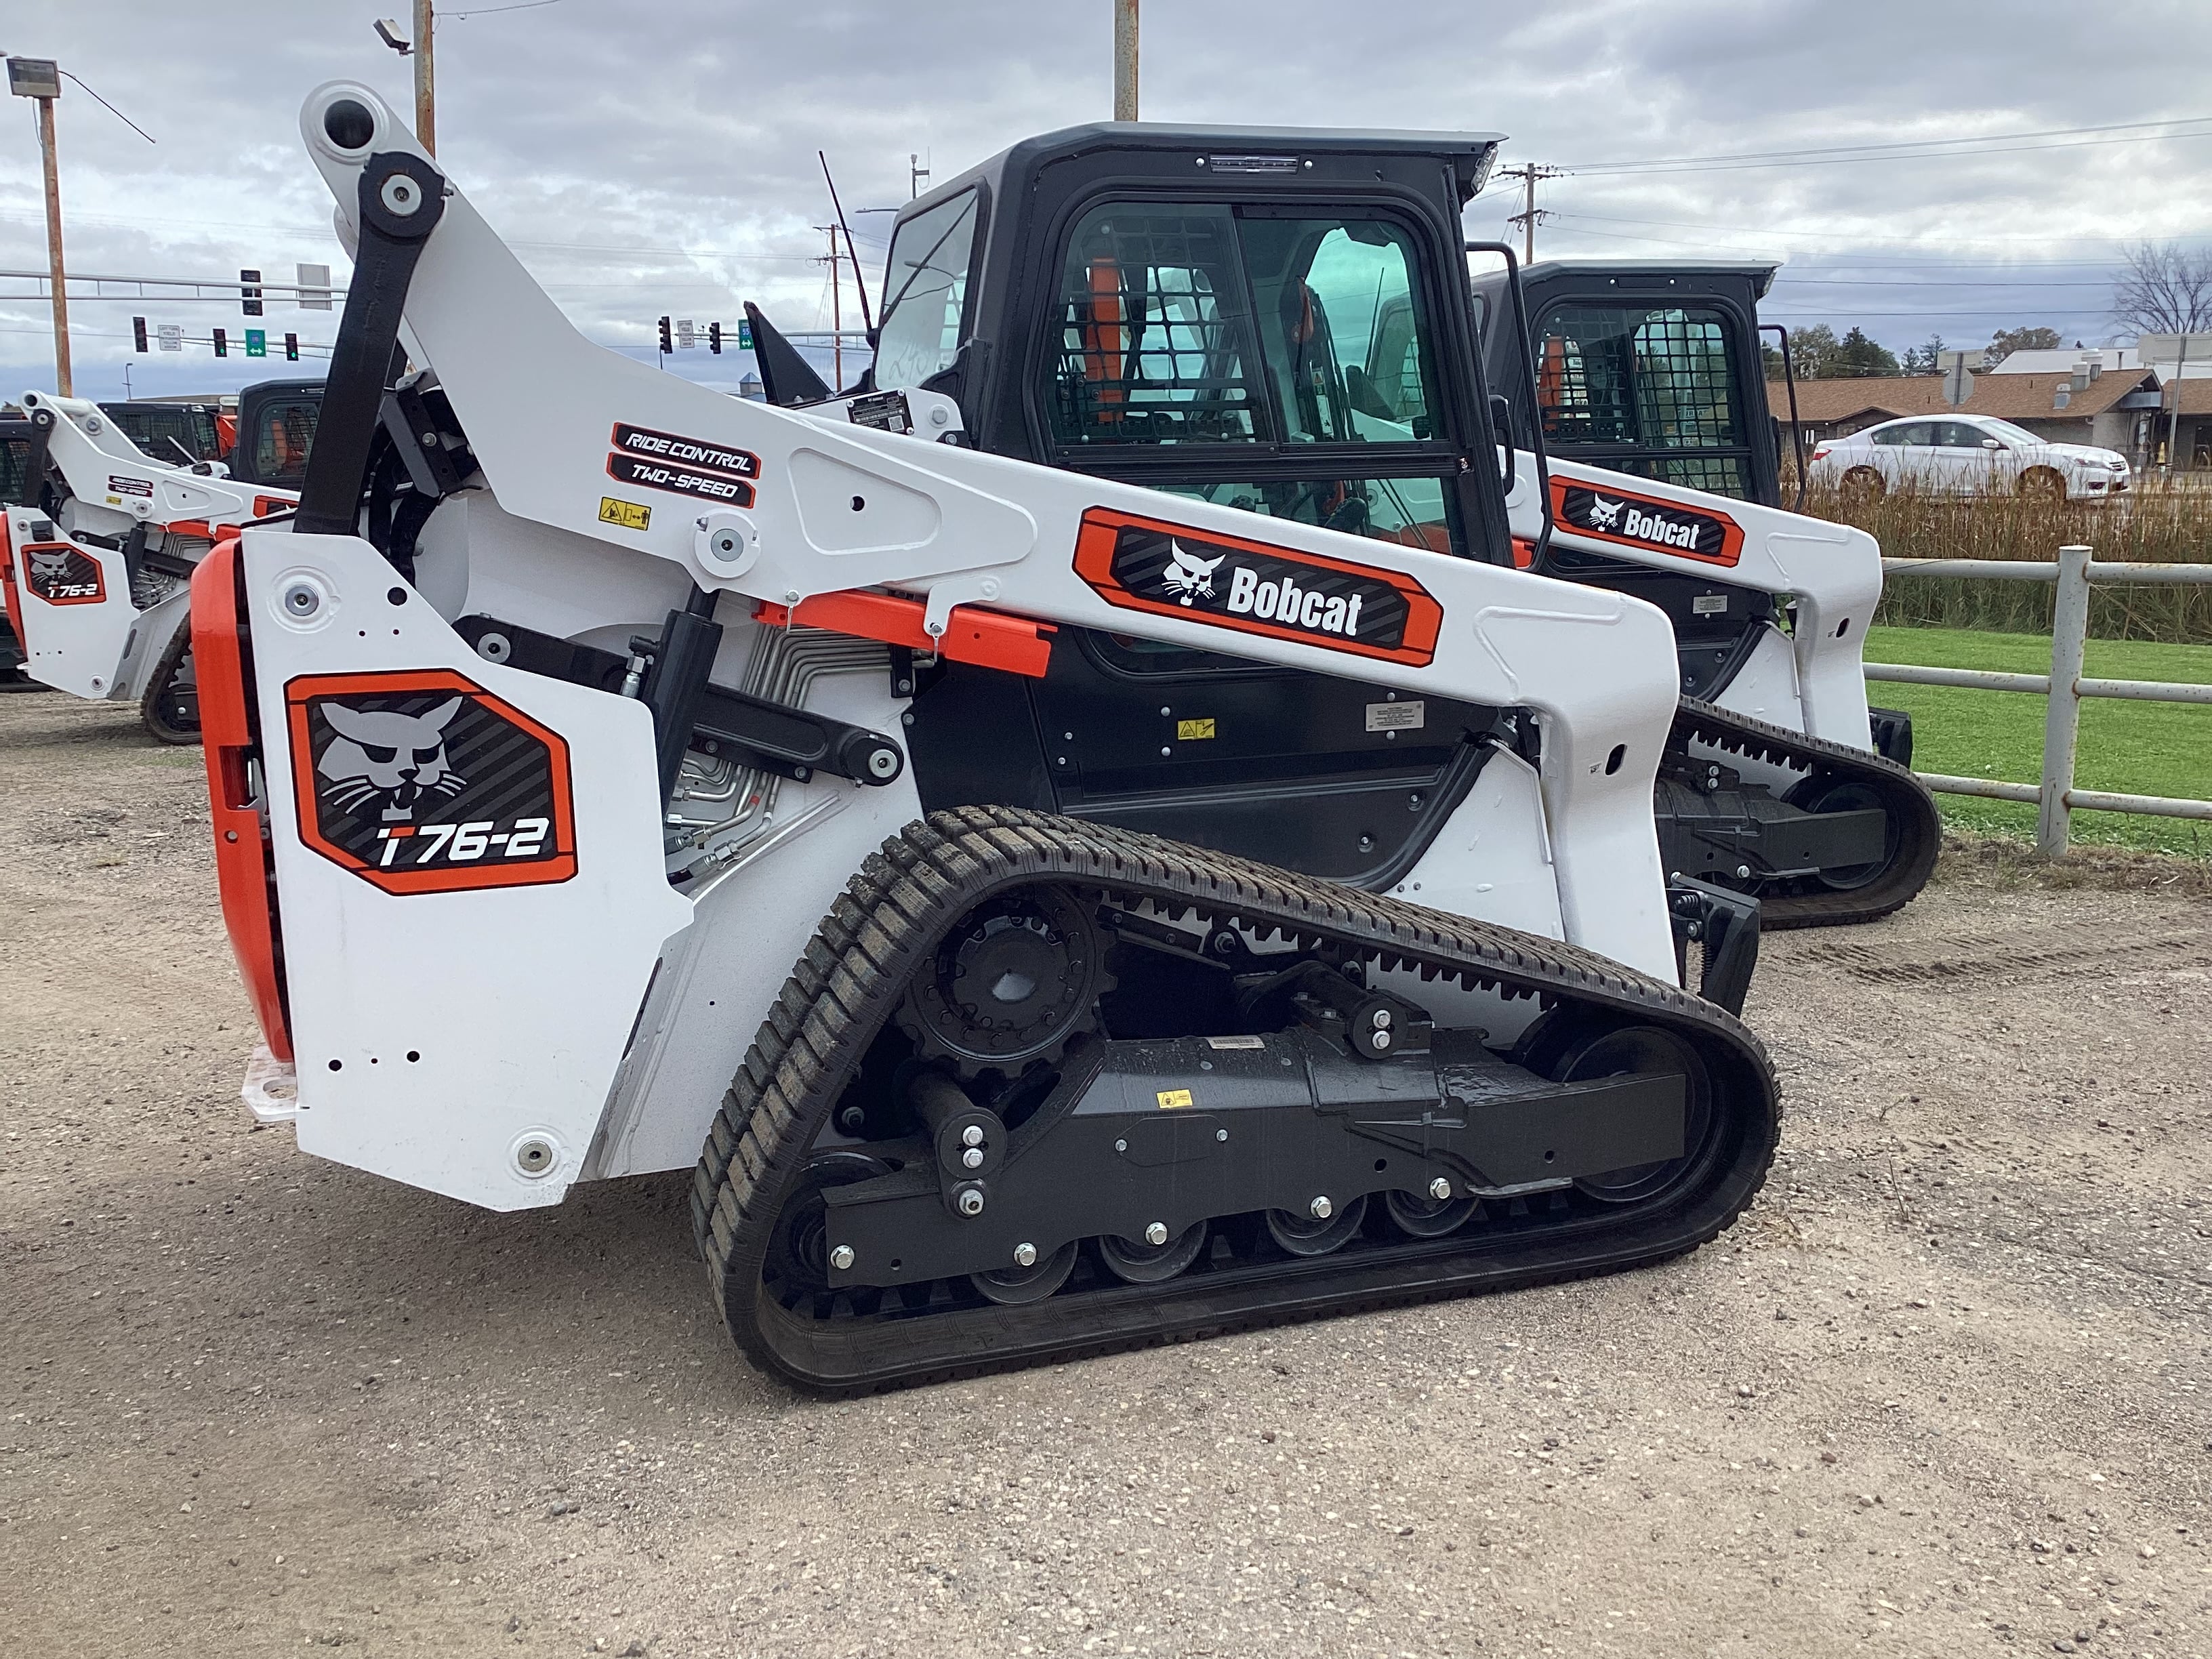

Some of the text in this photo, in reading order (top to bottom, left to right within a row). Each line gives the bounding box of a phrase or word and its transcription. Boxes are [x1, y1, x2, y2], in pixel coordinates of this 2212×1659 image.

[625, 433, 751, 472] RIDE CONTROL
[632, 464, 738, 498] TWO-SPEED
[1624, 508, 1700, 550] Bobcat
[1227, 567, 1362, 636] Bobcat
